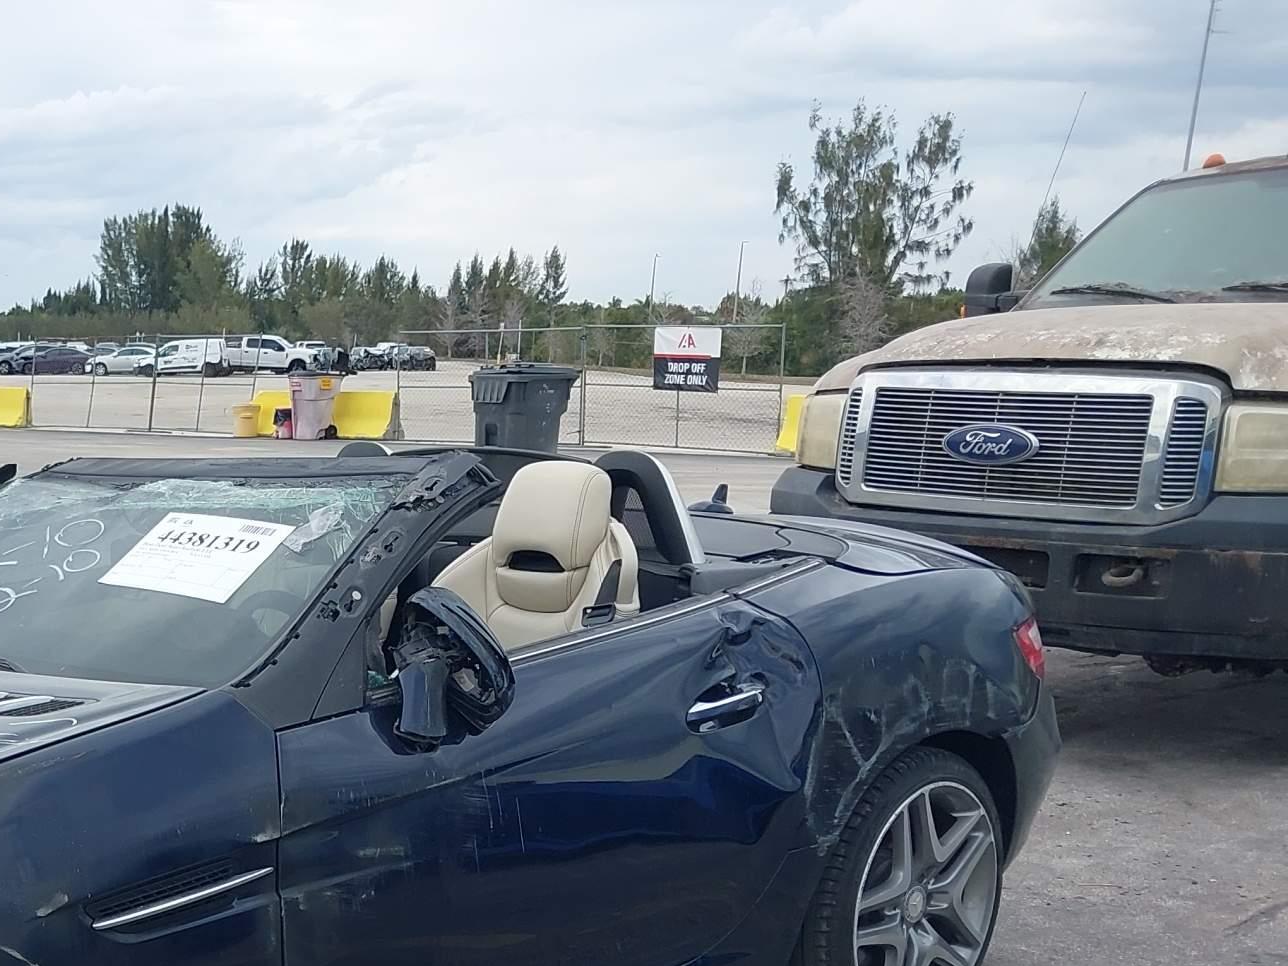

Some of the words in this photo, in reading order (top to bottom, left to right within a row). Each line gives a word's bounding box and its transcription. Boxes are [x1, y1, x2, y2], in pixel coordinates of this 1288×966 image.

[667, 362, 690, 373] DROP
[691, 362, 707, 373] OFF
[664, 374, 686, 385] ZONE
[687, 374, 708, 386] ONLY
[959, 430, 1013, 455] Ford
[157, 529, 260, 554] 44381319
